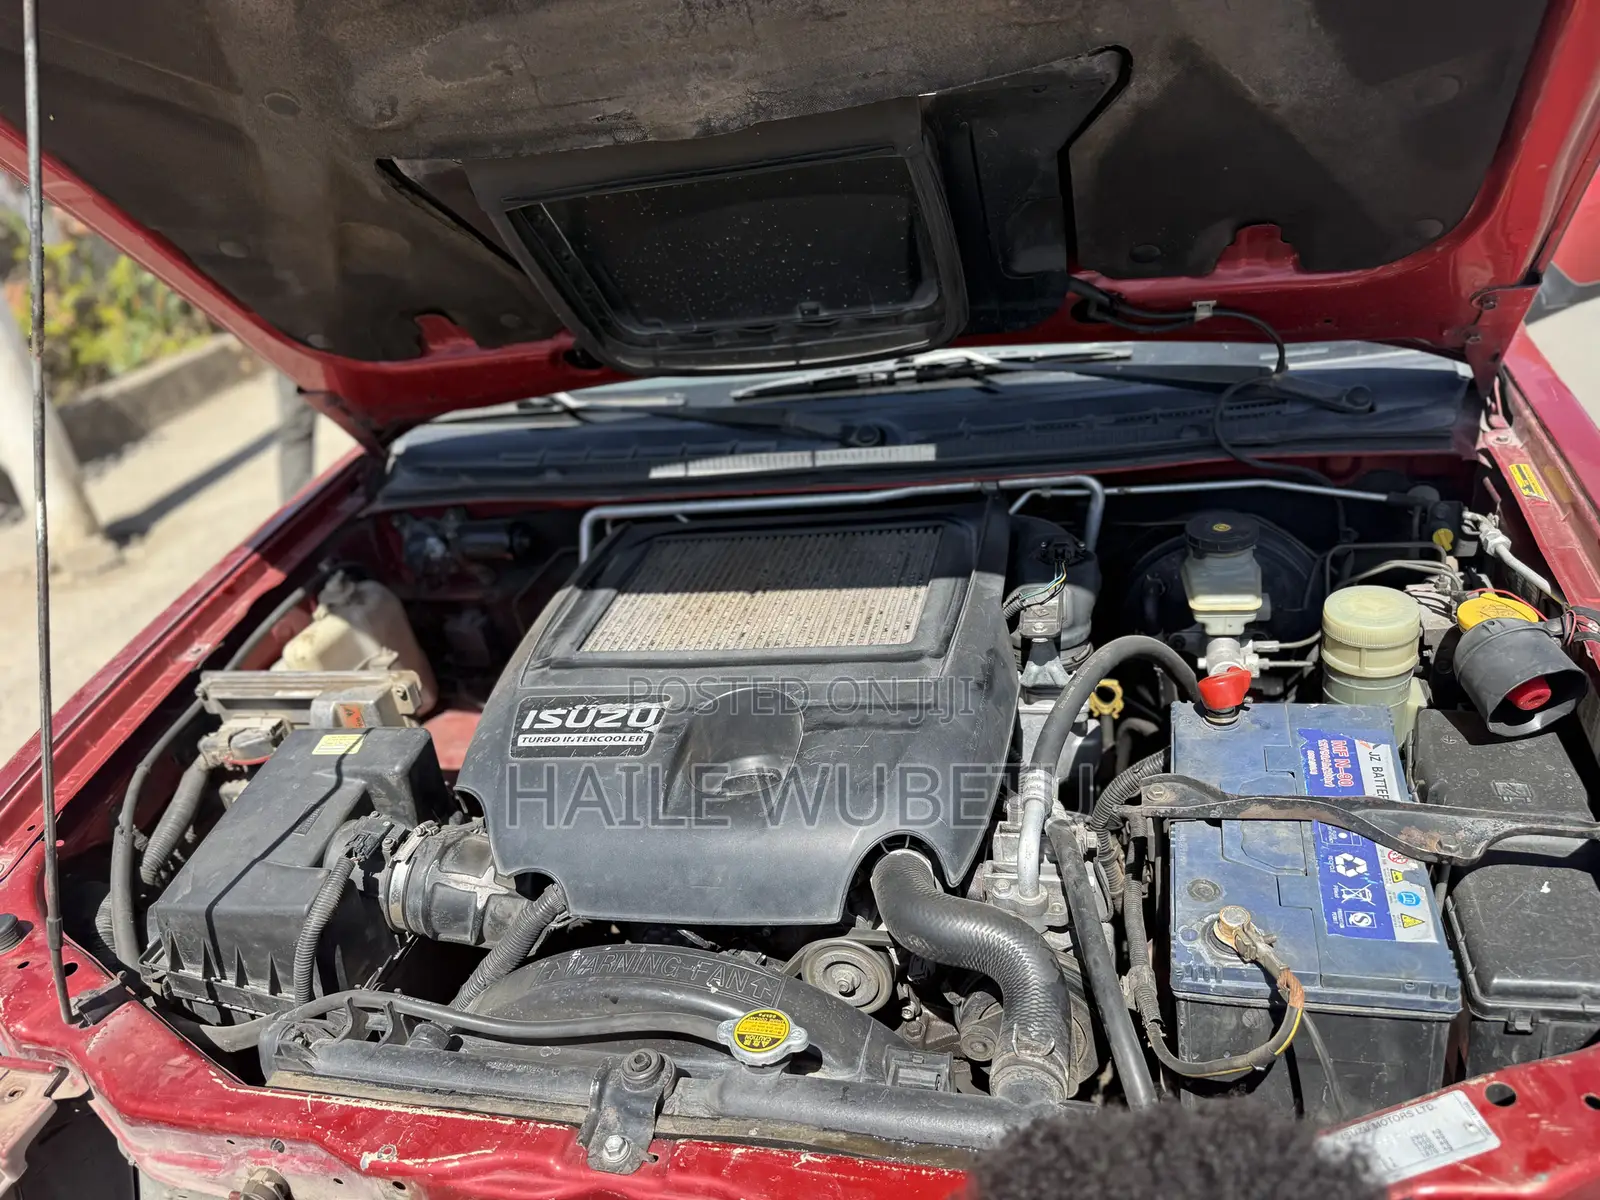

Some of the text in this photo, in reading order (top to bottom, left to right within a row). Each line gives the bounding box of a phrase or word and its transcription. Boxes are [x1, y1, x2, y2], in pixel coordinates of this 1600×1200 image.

[521, 706, 660, 729] ISUZU
[522, 734, 644, 744] TURBO INTERCOOLER
[1368, 751, 1382, 762] JZ
[1334, 758, 1354, 787] N-90
[1369, 1109, 1415, 1130] MOTORS
[1415, 1103, 1438, 1115] LTD.
